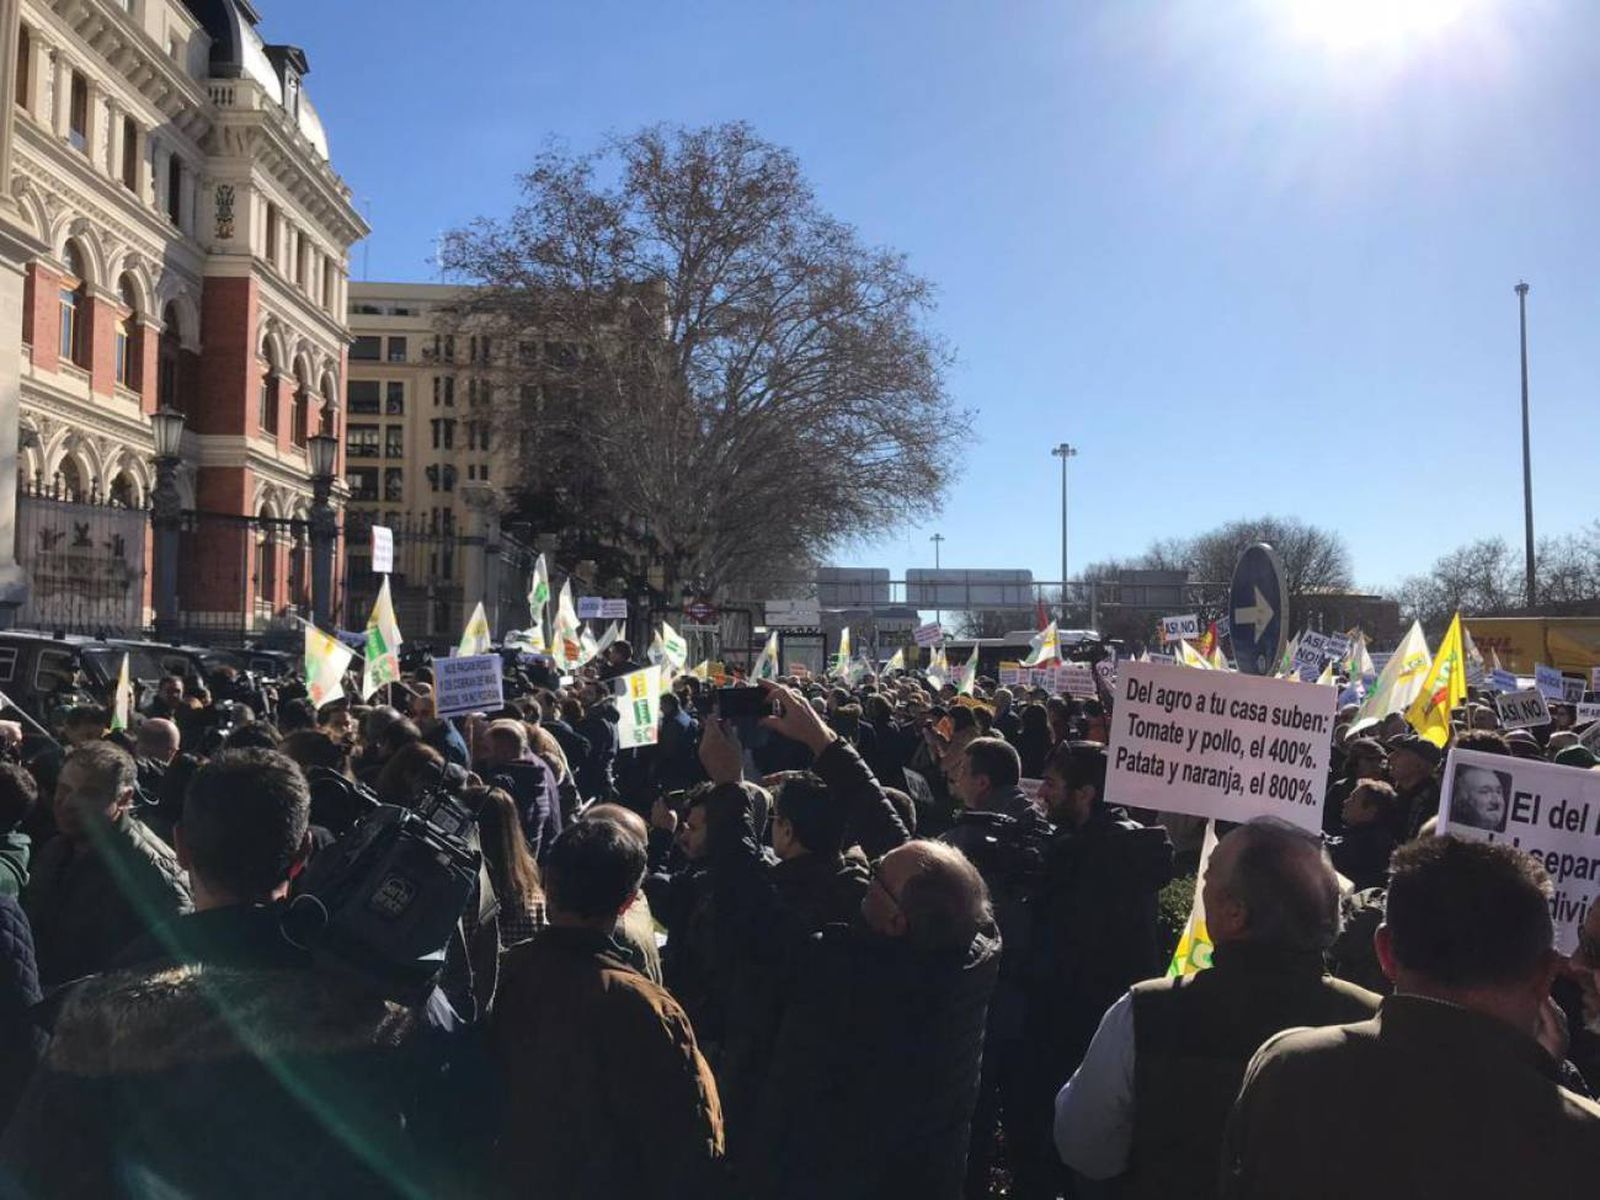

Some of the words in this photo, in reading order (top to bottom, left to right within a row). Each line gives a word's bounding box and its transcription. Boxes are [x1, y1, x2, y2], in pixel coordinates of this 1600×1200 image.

[1126, 678, 1153, 704] Del
[1156, 686, 1192, 713] agro
[1196, 696, 1206, 711] a
[1210, 692, 1225, 716] tu
[1230, 700, 1266, 723] casa
[1272, 705, 1329, 734] suben:
[1128, 713, 1184, 744] Tomate
[1187, 726, 1199, 753] y
[1200, 728, 1244, 759] pollo,
[1250, 736, 1266, 759] el
[1268, 738, 1317, 769] 400%.
[1115, 747, 1164, 776] Patata
[1168, 761, 1180, 785] y
[1182, 763, 1244, 796] naranja,
[1250, 772, 1265, 796] el
[1268, 775, 1317, 806] 800%.
[1511, 791, 1541, 825] El
[1548, 799, 1590, 833] del
